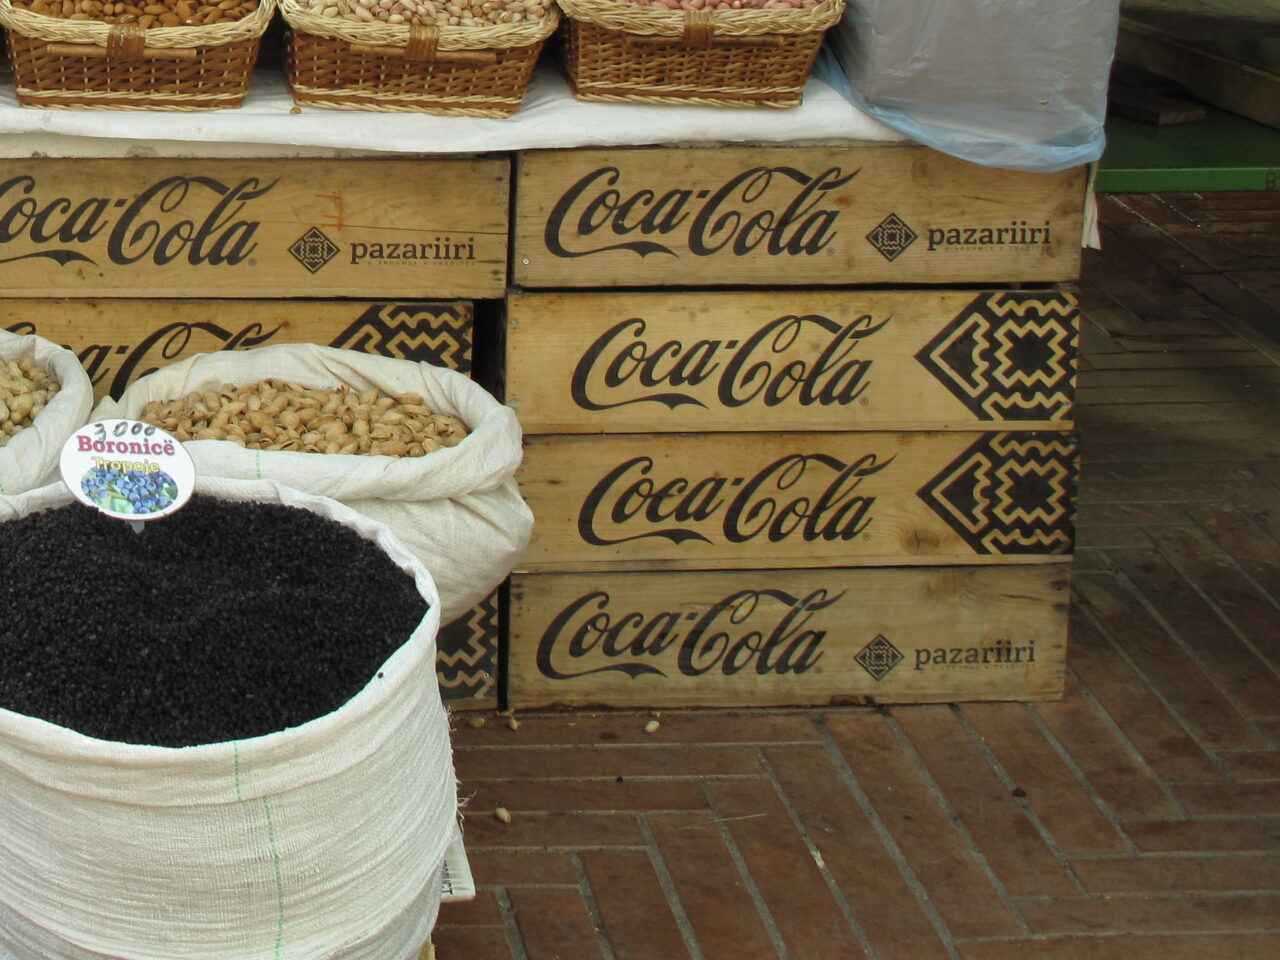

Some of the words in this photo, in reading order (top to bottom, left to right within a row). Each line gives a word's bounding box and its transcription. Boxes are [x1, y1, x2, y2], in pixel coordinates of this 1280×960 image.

[544, 166, 863, 259] Coca-Cola
[350, 237, 475, 265] pazariiri
[927, 221, 1051, 251] pazariiri
[570, 314, 893, 411] Coca-Cola
[76, 434, 175, 456] Boronicë
[91, 456, 160, 475] Tropoje
[577, 452, 898, 546] Coca-Cola
[536, 587, 849, 680] Coca-Cola
[914, 640, 1036, 670] pazariiri
